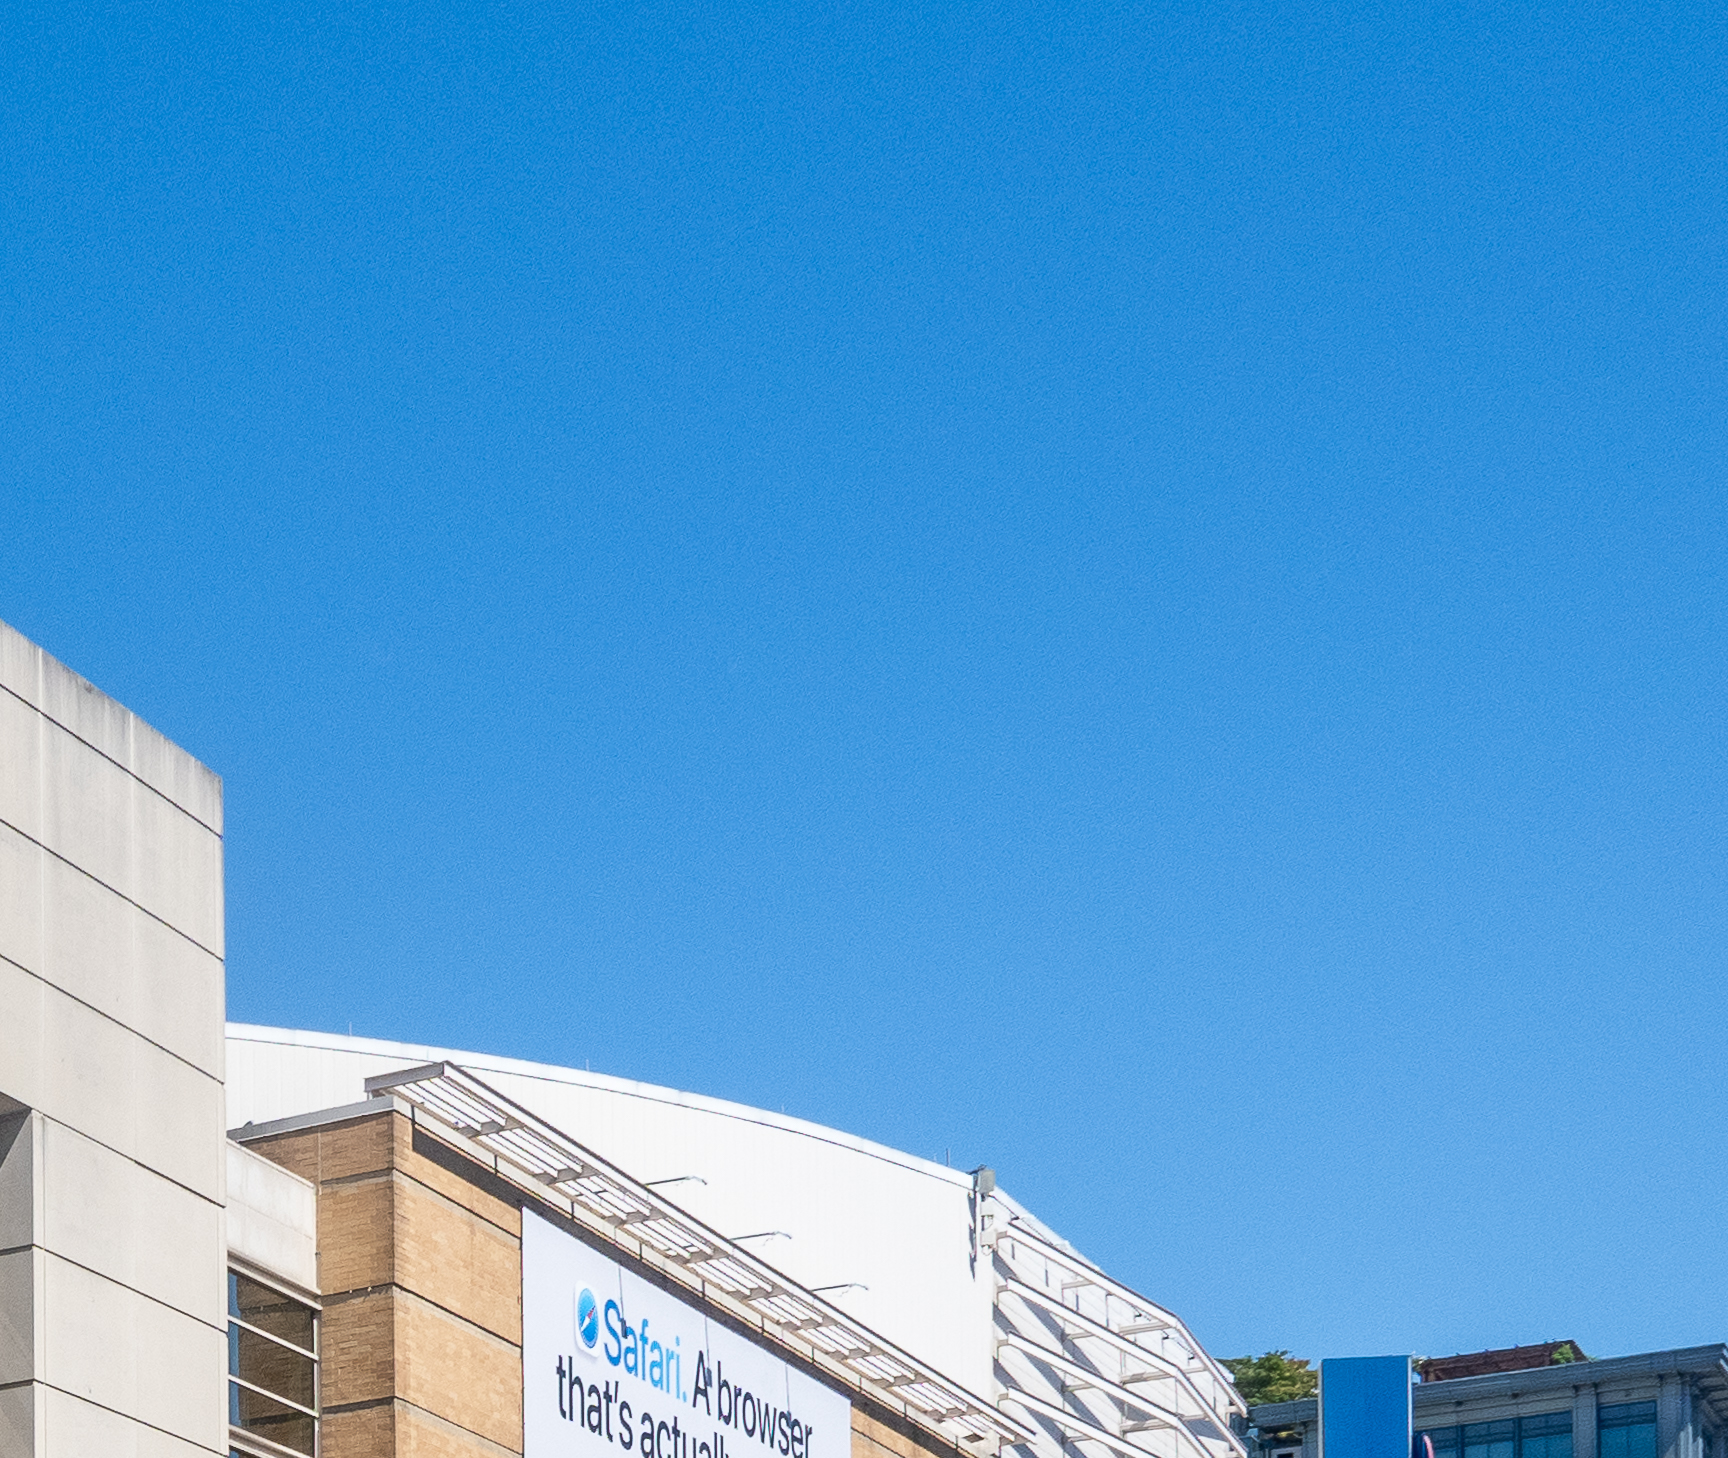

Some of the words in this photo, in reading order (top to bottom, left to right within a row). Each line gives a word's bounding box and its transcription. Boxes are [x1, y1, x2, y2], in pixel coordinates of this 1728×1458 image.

[556, 1355, 634, 1451] that's
[604, 1299, 687, 1402] Safari.
[693, 1350, 712, 1416] A
